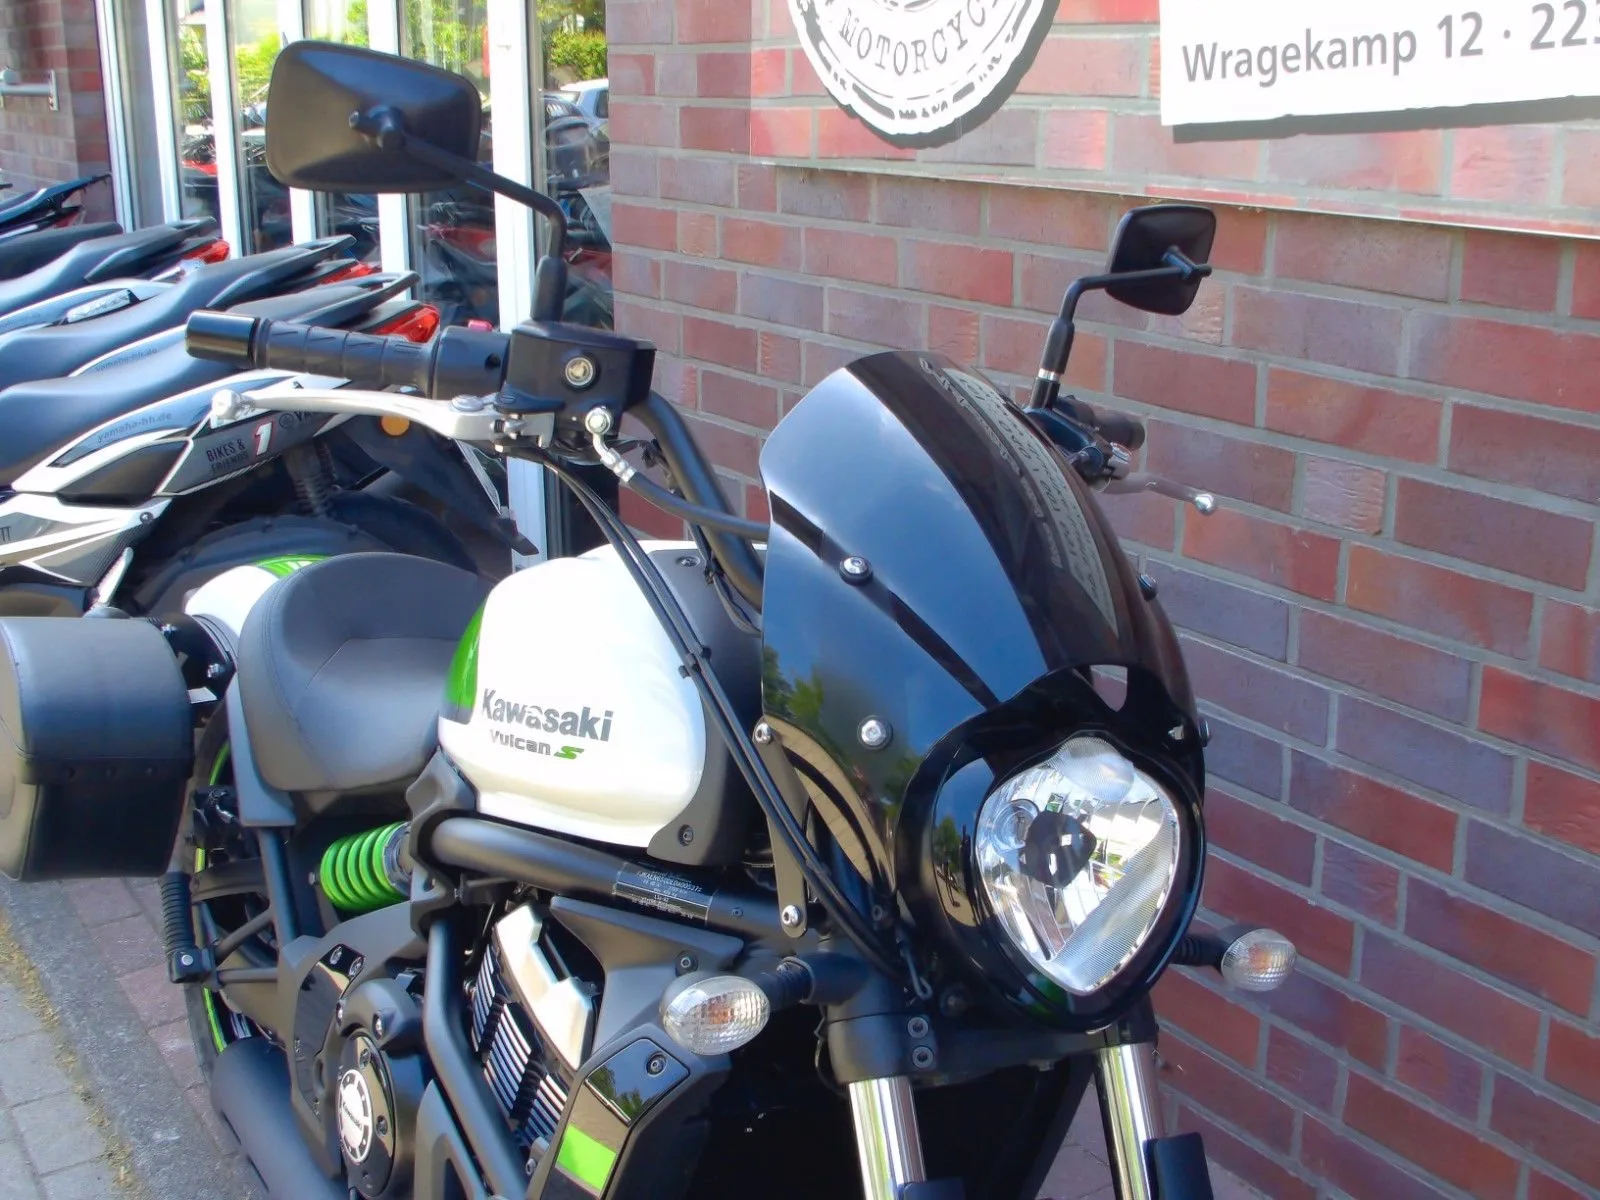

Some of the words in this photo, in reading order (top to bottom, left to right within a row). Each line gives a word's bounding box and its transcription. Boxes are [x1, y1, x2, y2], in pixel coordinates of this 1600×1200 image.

[838, 0, 998, 76] MOTORCYC
[1182, 28, 1417, 88] Wragekamp
[1437, 11, 1484, 59] 12
[98, 411, 173, 444] yamaha-hh.de
[254, 420, 275, 457] 1
[206, 441, 236, 462] BIKES
[237, 439, 247, 451] &
[482, 688, 615, 742] Kawasaki
[490, 729, 551, 756] Vulcan
[553, 745, 585, 760] S
